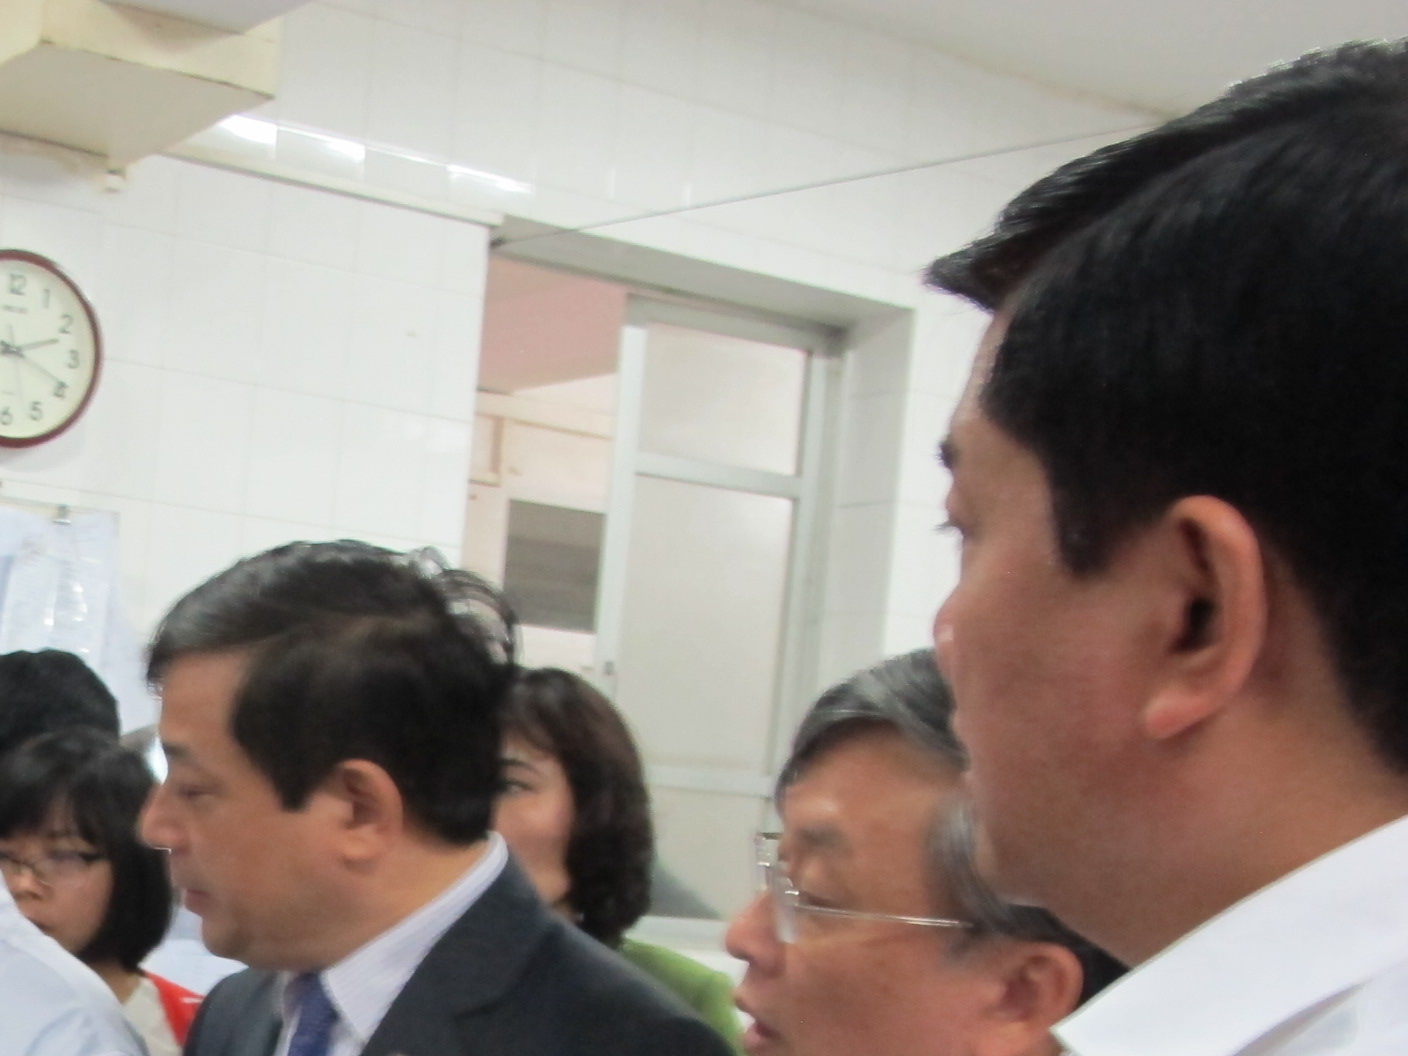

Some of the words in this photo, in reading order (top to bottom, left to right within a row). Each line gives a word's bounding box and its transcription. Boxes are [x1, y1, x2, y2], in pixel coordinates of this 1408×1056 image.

[9, 273, 26, 295] 12
[58, 313, 74, 334] 2
[66, 349, 80, 369] 3
[53, 380, 69, 399] 4
[29, 400, 43, 421] 5
